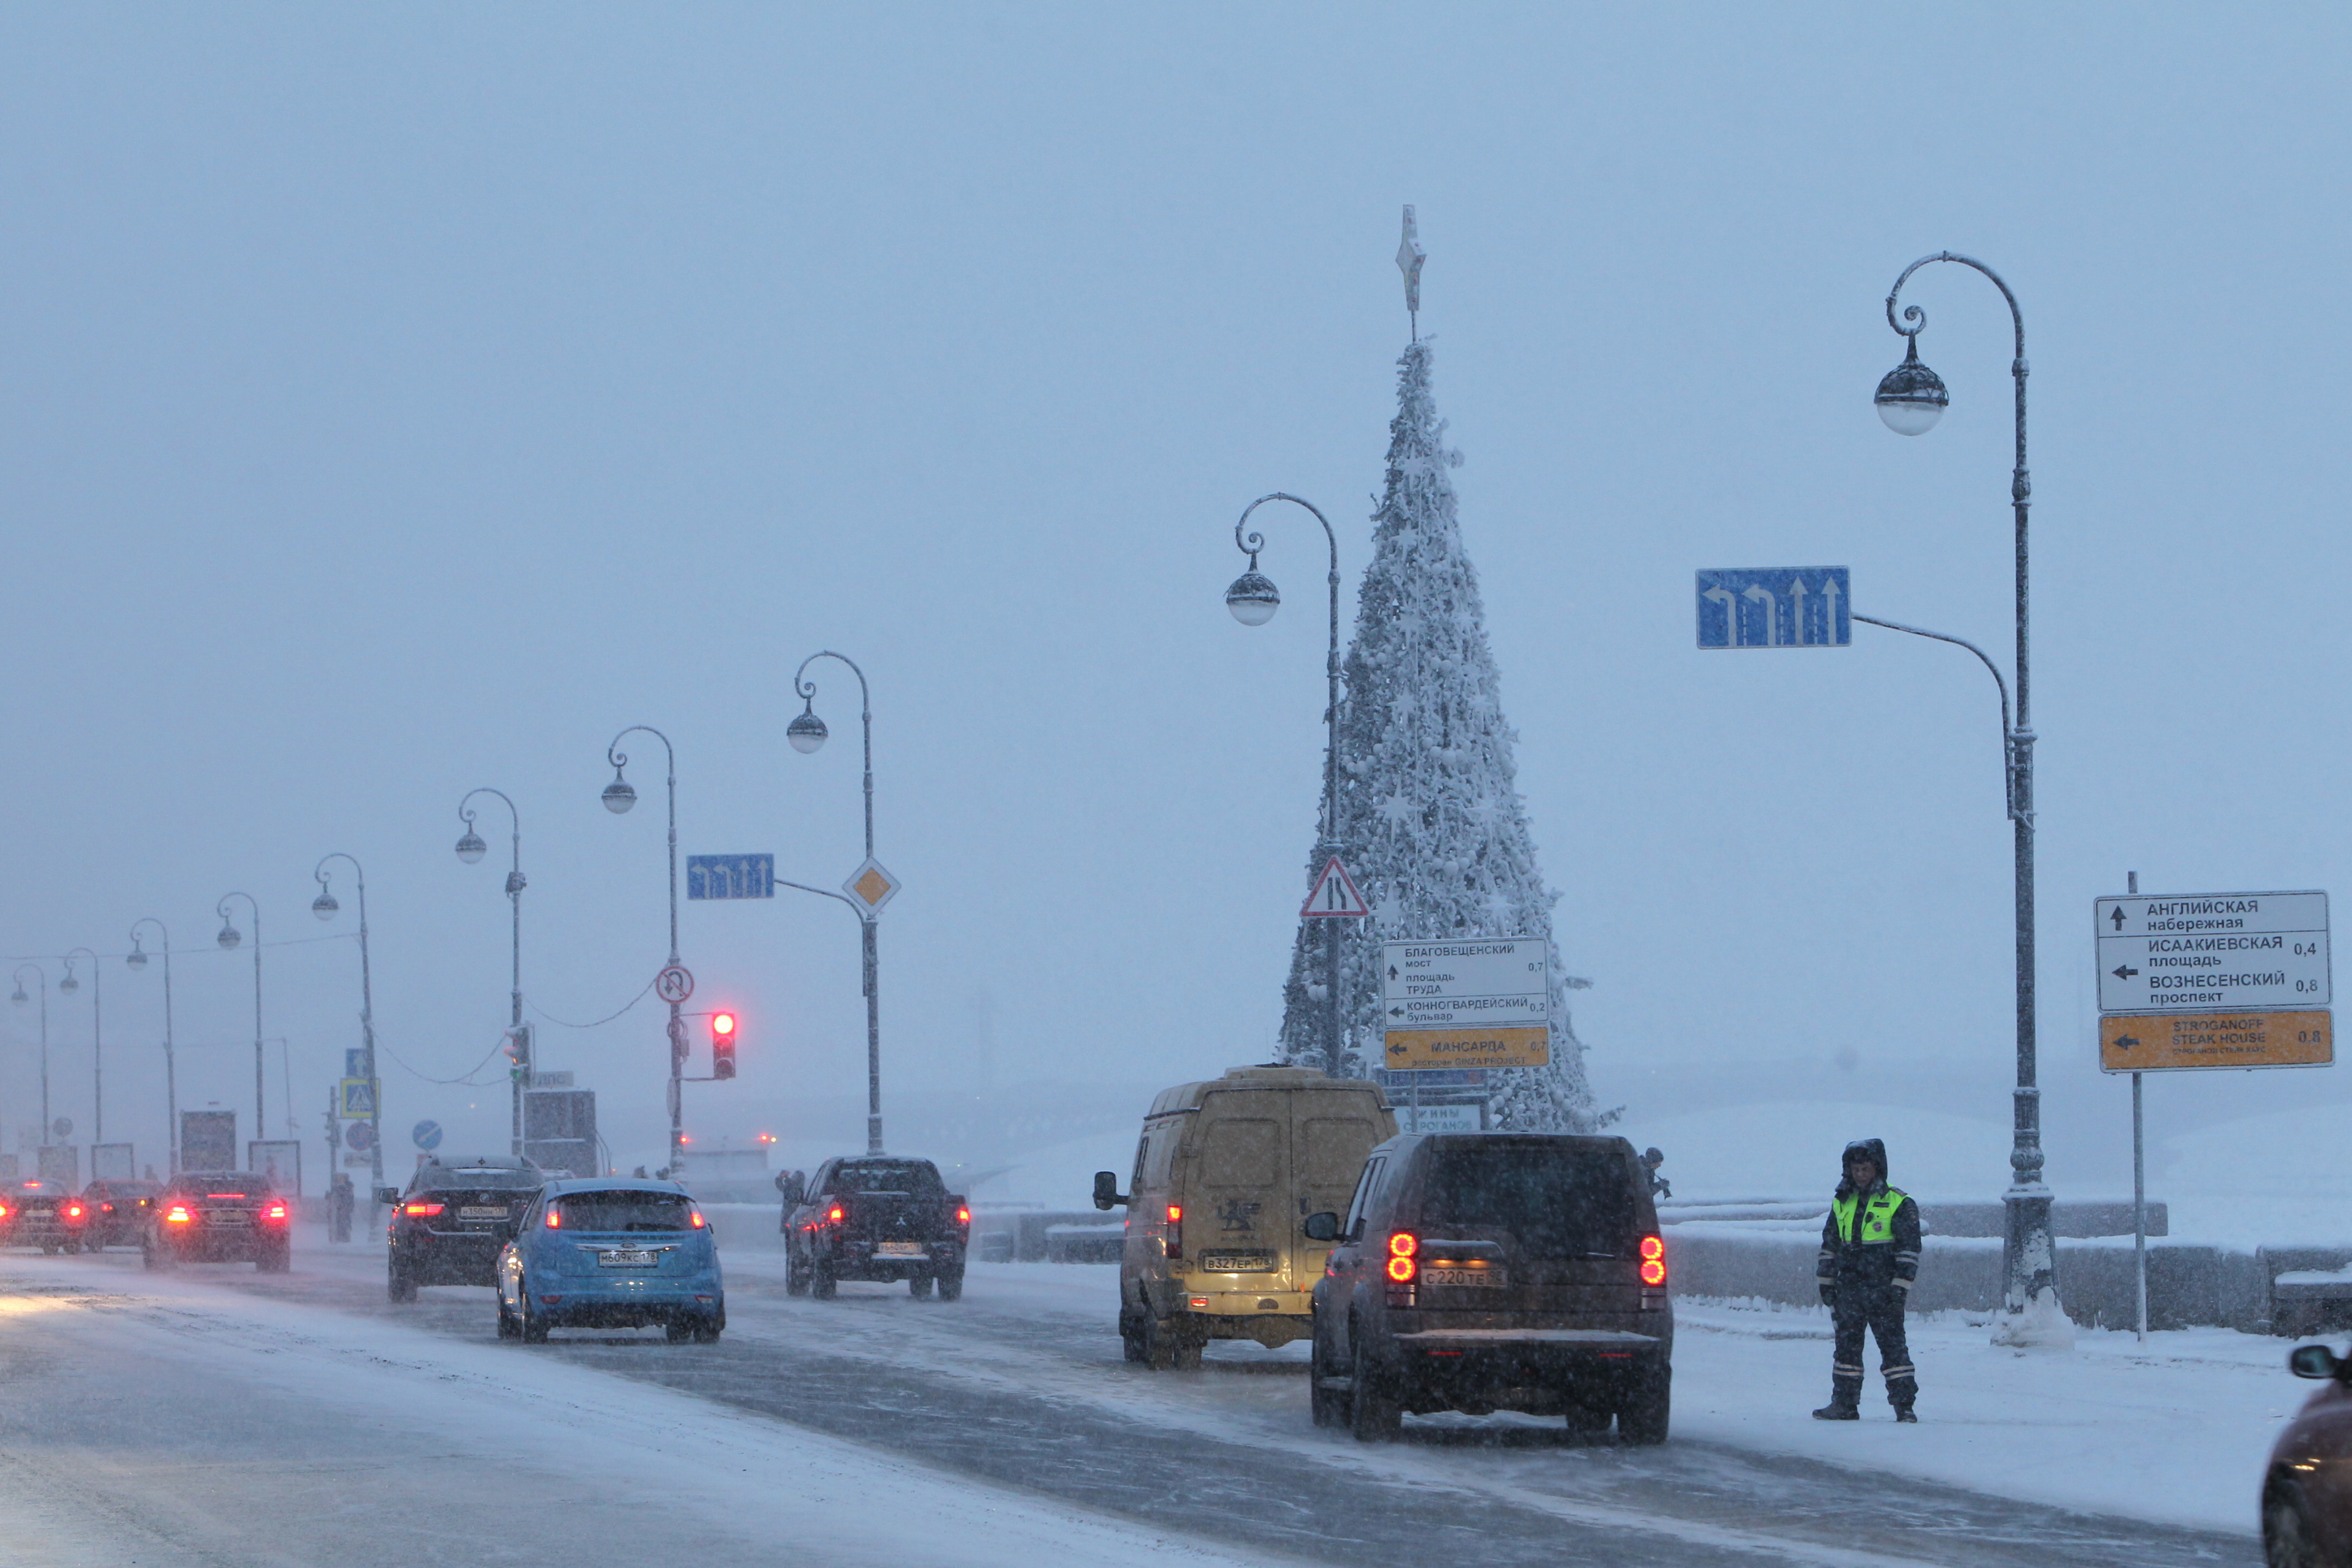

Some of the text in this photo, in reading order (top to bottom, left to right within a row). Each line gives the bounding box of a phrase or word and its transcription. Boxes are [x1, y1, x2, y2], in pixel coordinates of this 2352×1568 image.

[2147, 899, 2258, 916] АНГЛИЙСКАЯ
[2148, 919, 2243, 932] набережная
[2149, 936, 2282, 952] ИСААКИЕВСКАЯ
[2294, 942, 2316, 957] 0,4
[1405, 945, 1515, 958] БЛАГОВЕЩЕНСКИЙ
[1528, 963, 1543, 972] 0,7
[2149, 956, 2221, 967] площадь
[1406, 974, 1455, 982] площадь
[2150, 970, 2285, 988] ВОЗНЕСЕНСКИЙ
[1407, 985, 1442, 995] ТРУДА
[2296, 979, 2318, 993] 0,8
[1407, 998, 1528, 1011] КОННОГВАРДЕЙСКИЙ
[2151, 993, 2224, 1006] проспект
[1530, 1003, 1545, 1013] 0,2
[1407, 1012, 1453, 1022] бульвар
[2173, 1019, 2263, 1031] STROGANOFF
[2172, 1032, 2265, 1045] STEAK HOUSE
[1431, 1041, 1506, 1052] МАНСАРДА
[1455, 1057, 1482, 1065] GINZA
[1485, 1057, 1526, 1065] PROJECT
[1403, 1122, 1472, 1131] СРОГАНОВ
